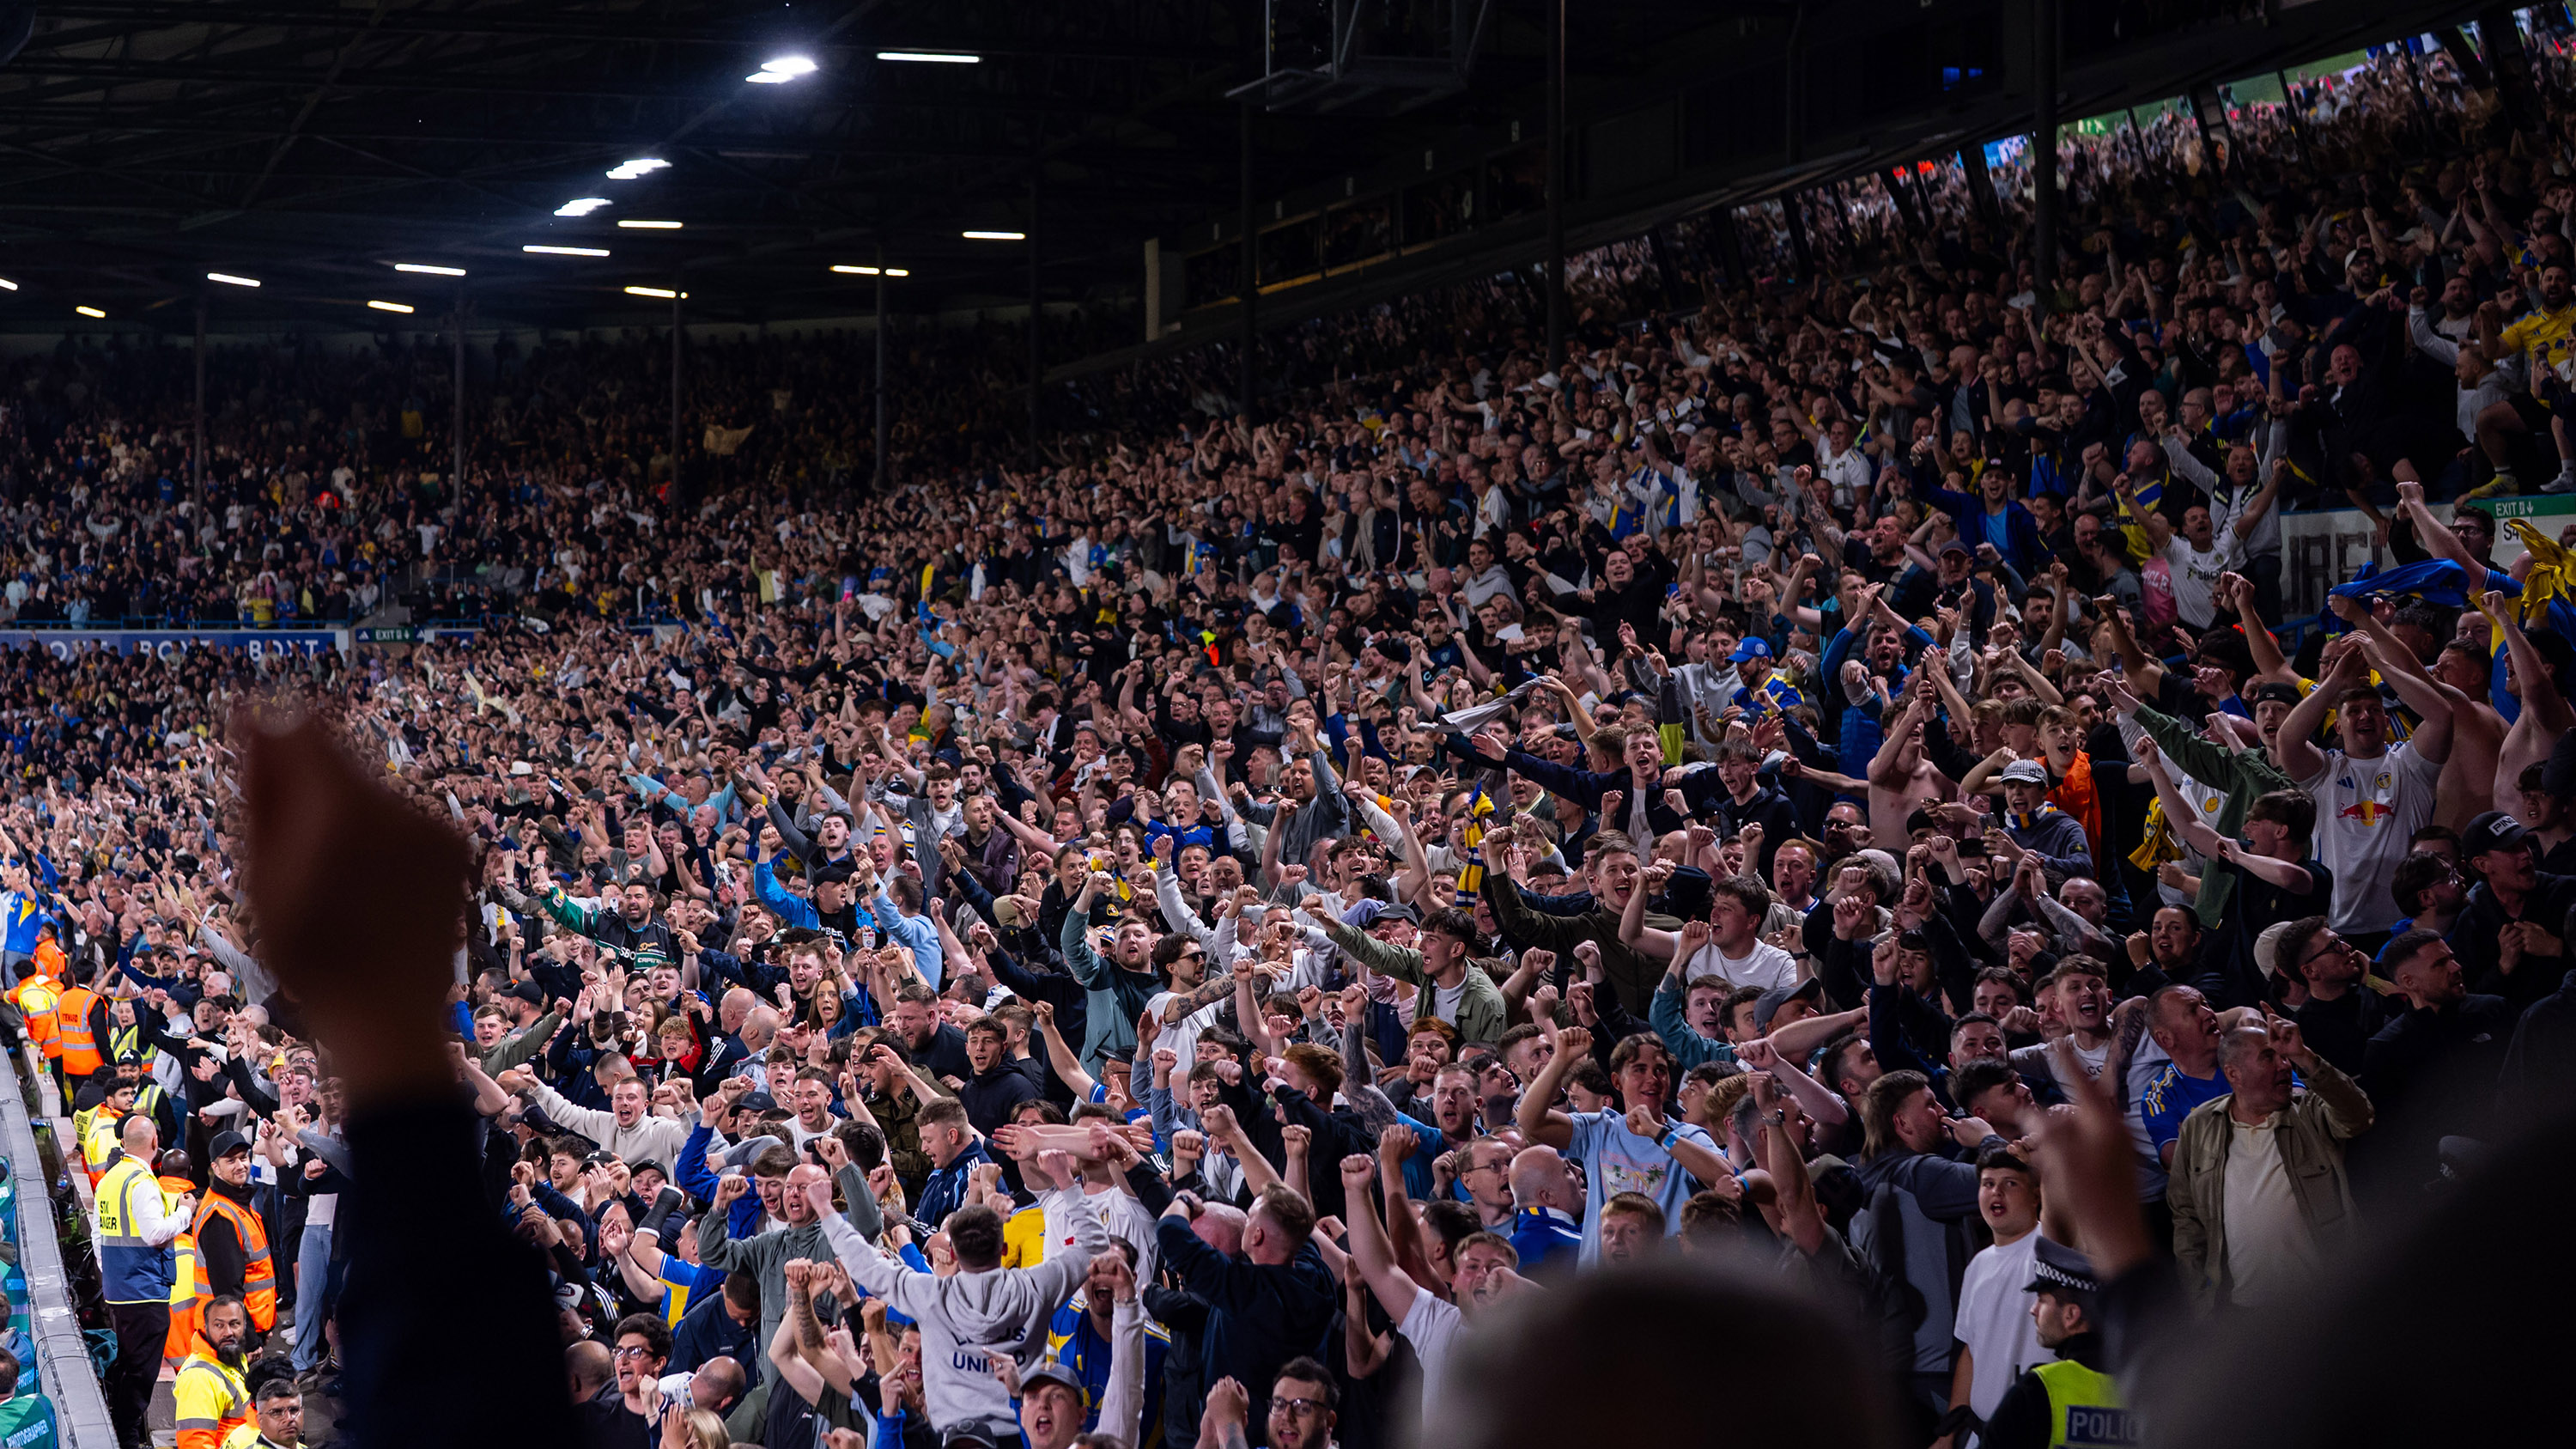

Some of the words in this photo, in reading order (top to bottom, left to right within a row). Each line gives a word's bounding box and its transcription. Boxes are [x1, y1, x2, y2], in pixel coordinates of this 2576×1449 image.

[2495, 502, 2517, 516] EXIT
[375, 629, 394, 641] EXIT
[953, 1349, 1027, 1373] UNID
[5, 1419, 49, 1449] PHOTOGRAPHER
[2070, 1410, 2138, 1441] POLIC
